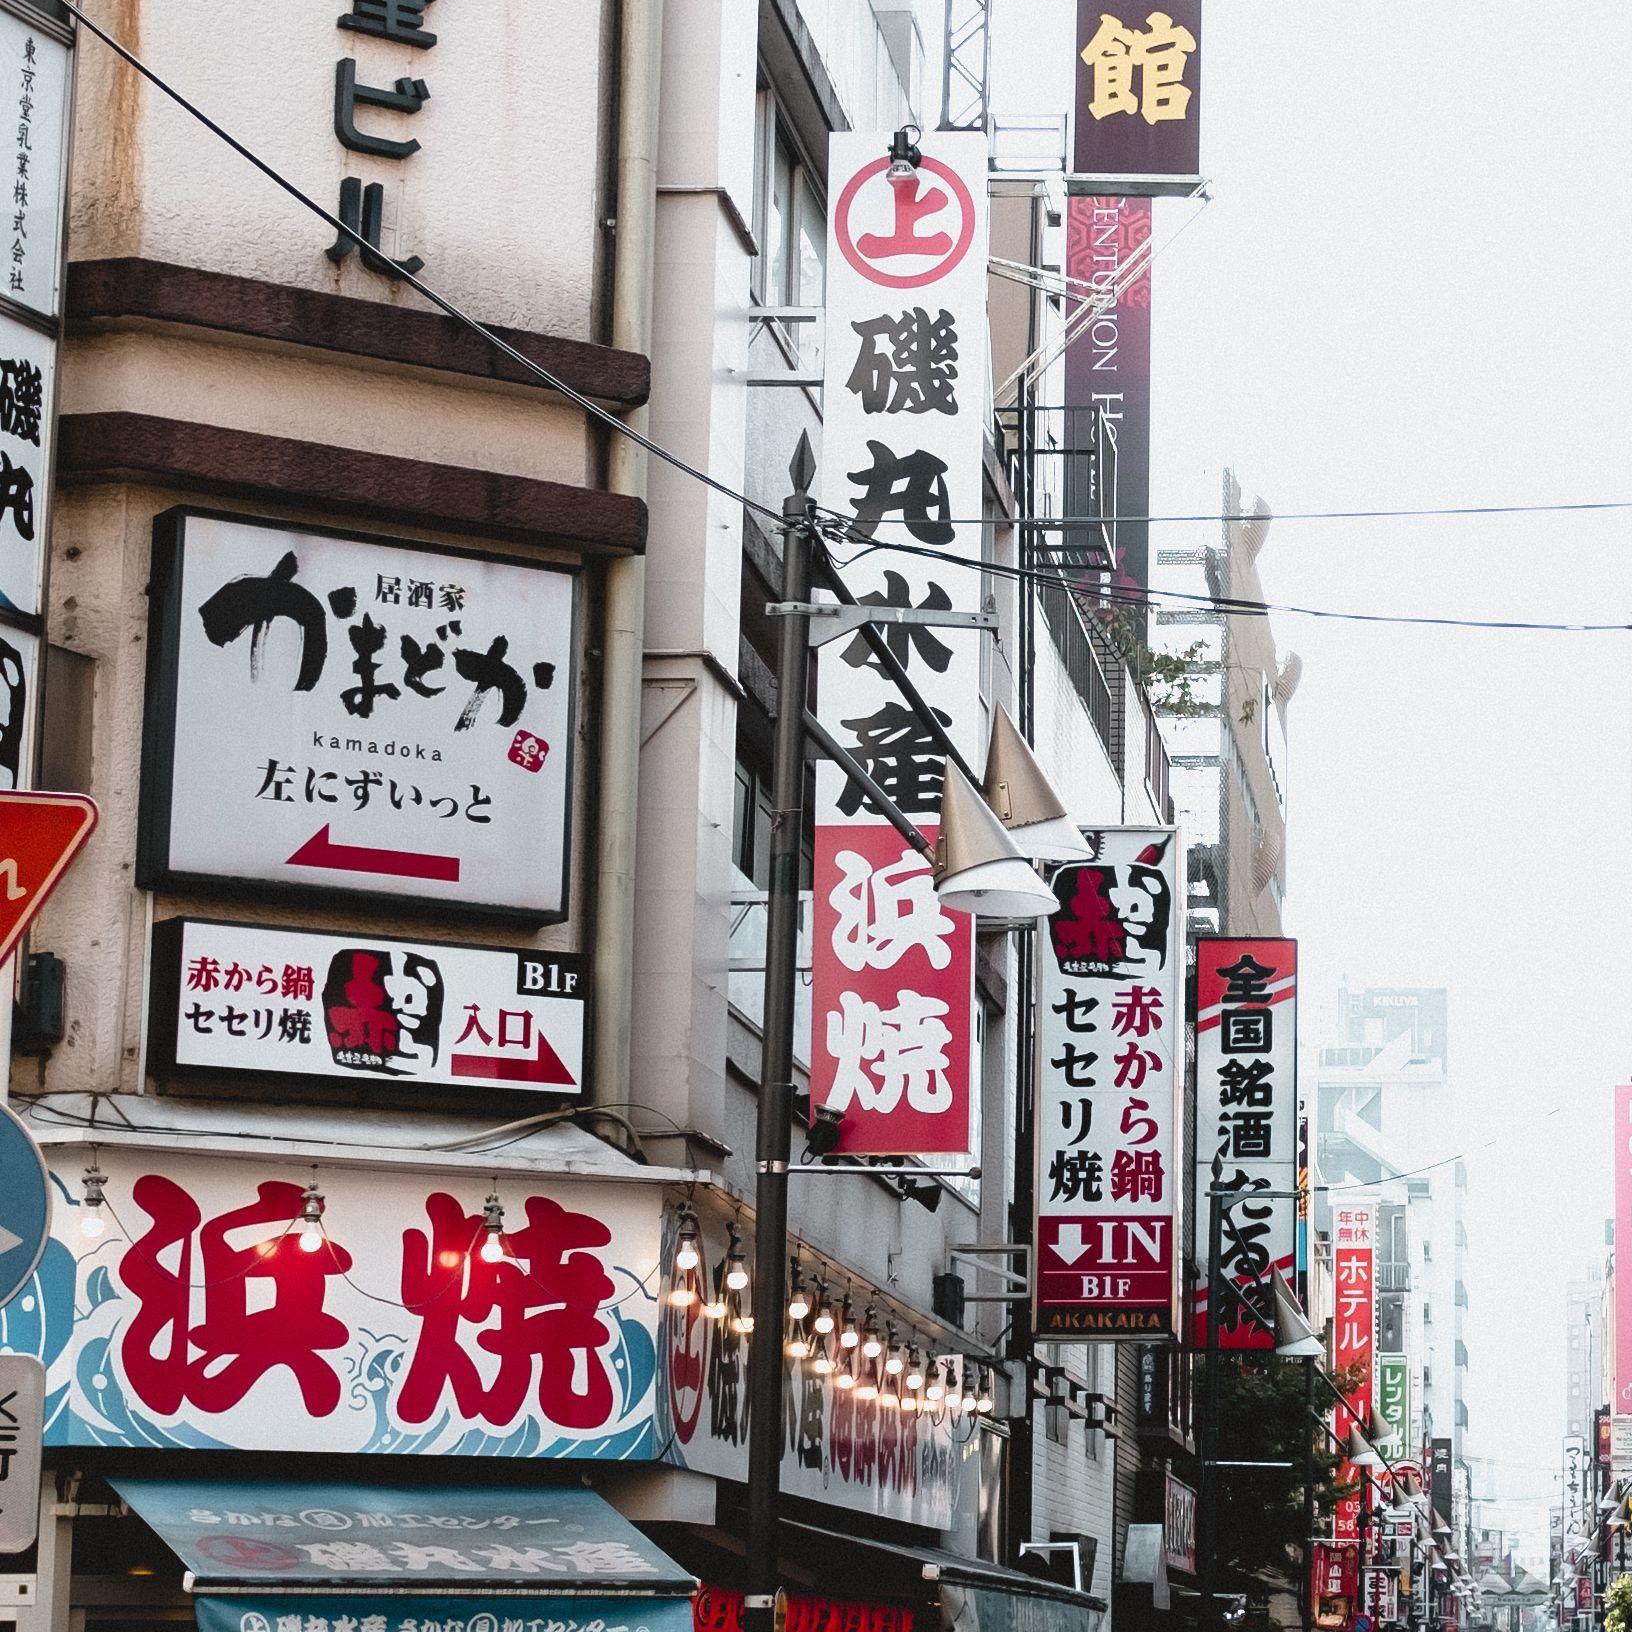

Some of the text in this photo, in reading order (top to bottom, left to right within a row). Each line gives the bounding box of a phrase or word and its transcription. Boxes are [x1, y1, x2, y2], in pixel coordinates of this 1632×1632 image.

[9, 37, 38, 293] 東京堂乳業株式会社
[1092, 197, 1126, 372] ENTURION
[835, 306, 960, 818] 磯丸水産
[375, 571, 466, 613] 居酒家
[199, 551, 556, 734] かまどか
[313, 730, 445, 762] kamadoka
[257, 758, 493, 825] 左にずいっと
[186, 956, 315, 1002] 赤から鍋
[523, 961, 578, 994] B1F
[826, 849, 955, 1113] 浜焼
[184, 1002, 312, 1045] セセリ焼
[454, 1002, 534, 1050] 入口
[1049, 987, 1103, 1204] セセリ焼
[1111, 985, 1165, 1204] 赤から鍋
[1096, 1221, 1161, 1264] IN
[119, 1174, 616, 1429] 浜焼
[1081, 1274, 1130, 1299] B1F
[1340, 1257, 1369, 1351] ホテル
[1050, 1312, 1161, 1328] AKAKARA
[296, 1540, 659, 1574] 磯丸水産
